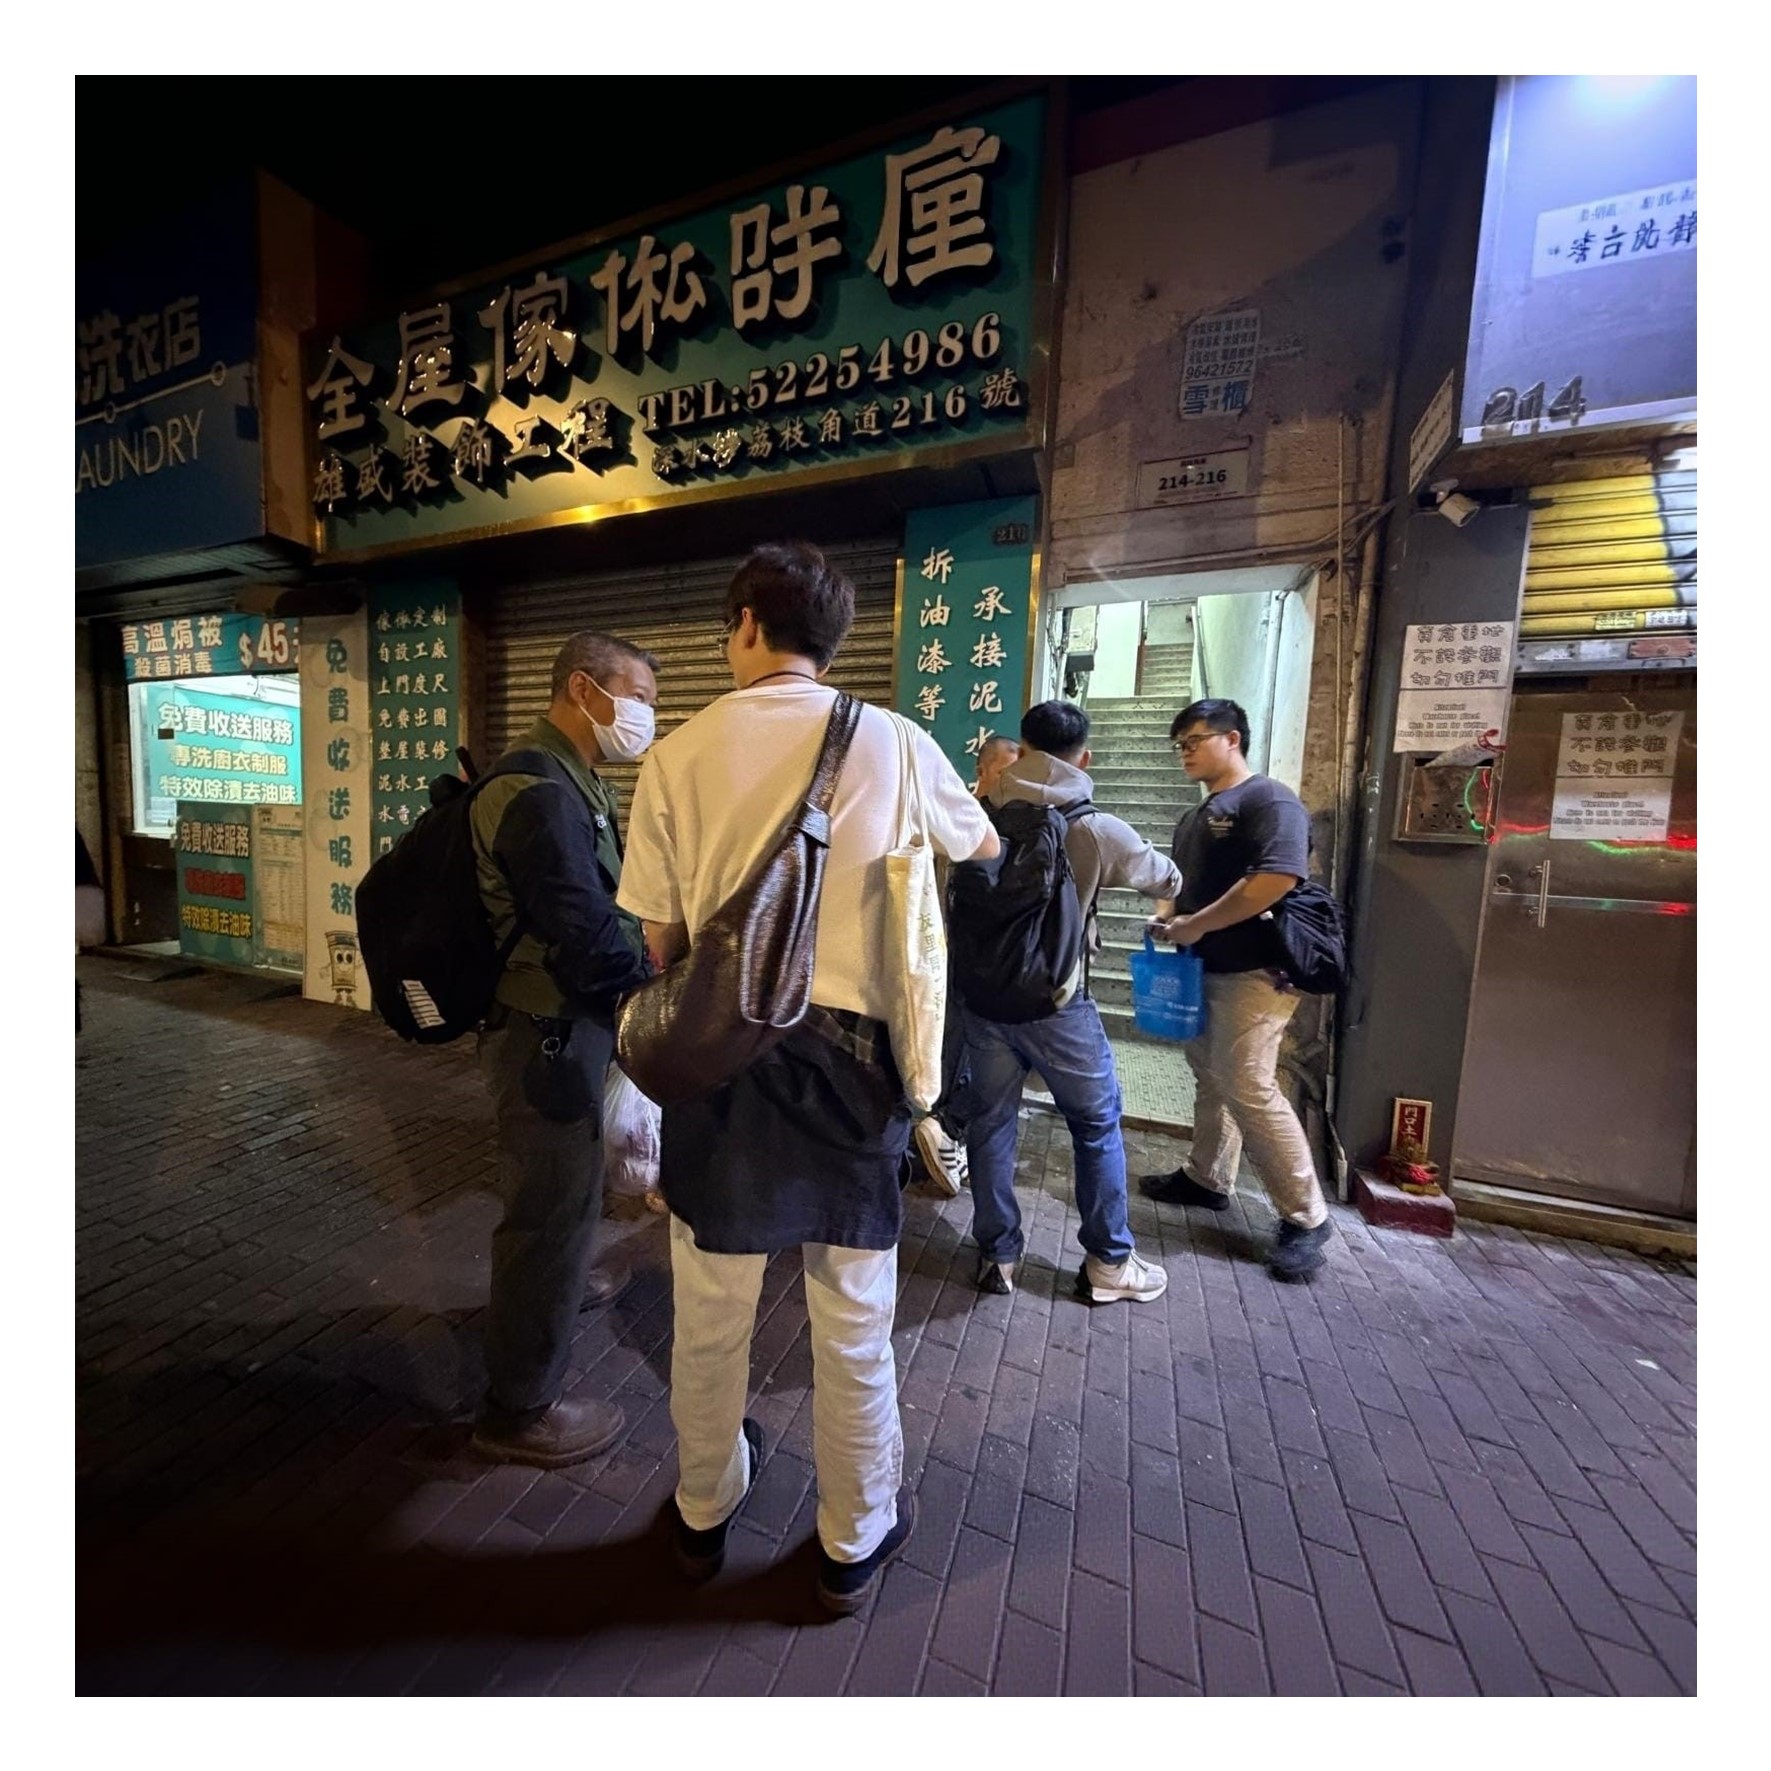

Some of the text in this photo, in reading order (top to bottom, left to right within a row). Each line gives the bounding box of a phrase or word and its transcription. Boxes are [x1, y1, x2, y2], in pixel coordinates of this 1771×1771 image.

[1185, 360, 1254, 380] 96421572
[1481, 376, 1587, 441] 214
[1157, 469, 1227, 491] 214-216
[377, 638, 447, 663] 自設工廠
[134, 651, 213, 677] 殺菌消毒
[377, 673, 449, 695] 上門度尺
[158, 702, 294, 745] 免費收送服務
[326, 638, 353, 916] 免費收送服務
